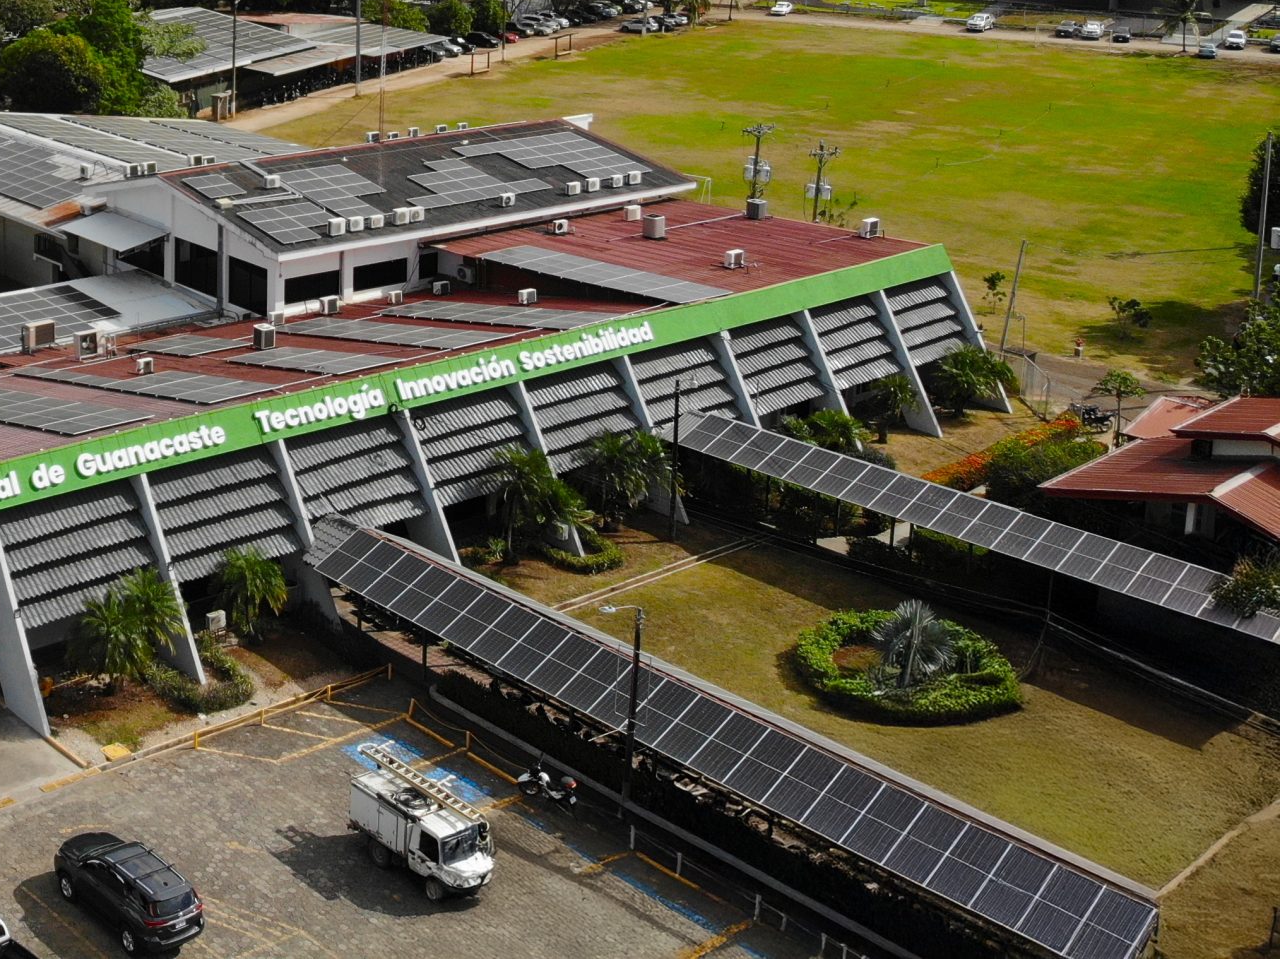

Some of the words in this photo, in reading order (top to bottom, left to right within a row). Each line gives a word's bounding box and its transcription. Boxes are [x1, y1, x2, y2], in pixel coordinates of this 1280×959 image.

[32, 462, 66, 488] de
[77, 425, 227, 476] Guanacaste
[255, 384, 387, 432] Tecnología
[396, 354, 516, 399] Innovación
[519, 321, 654, 372] Sostenibilidad
